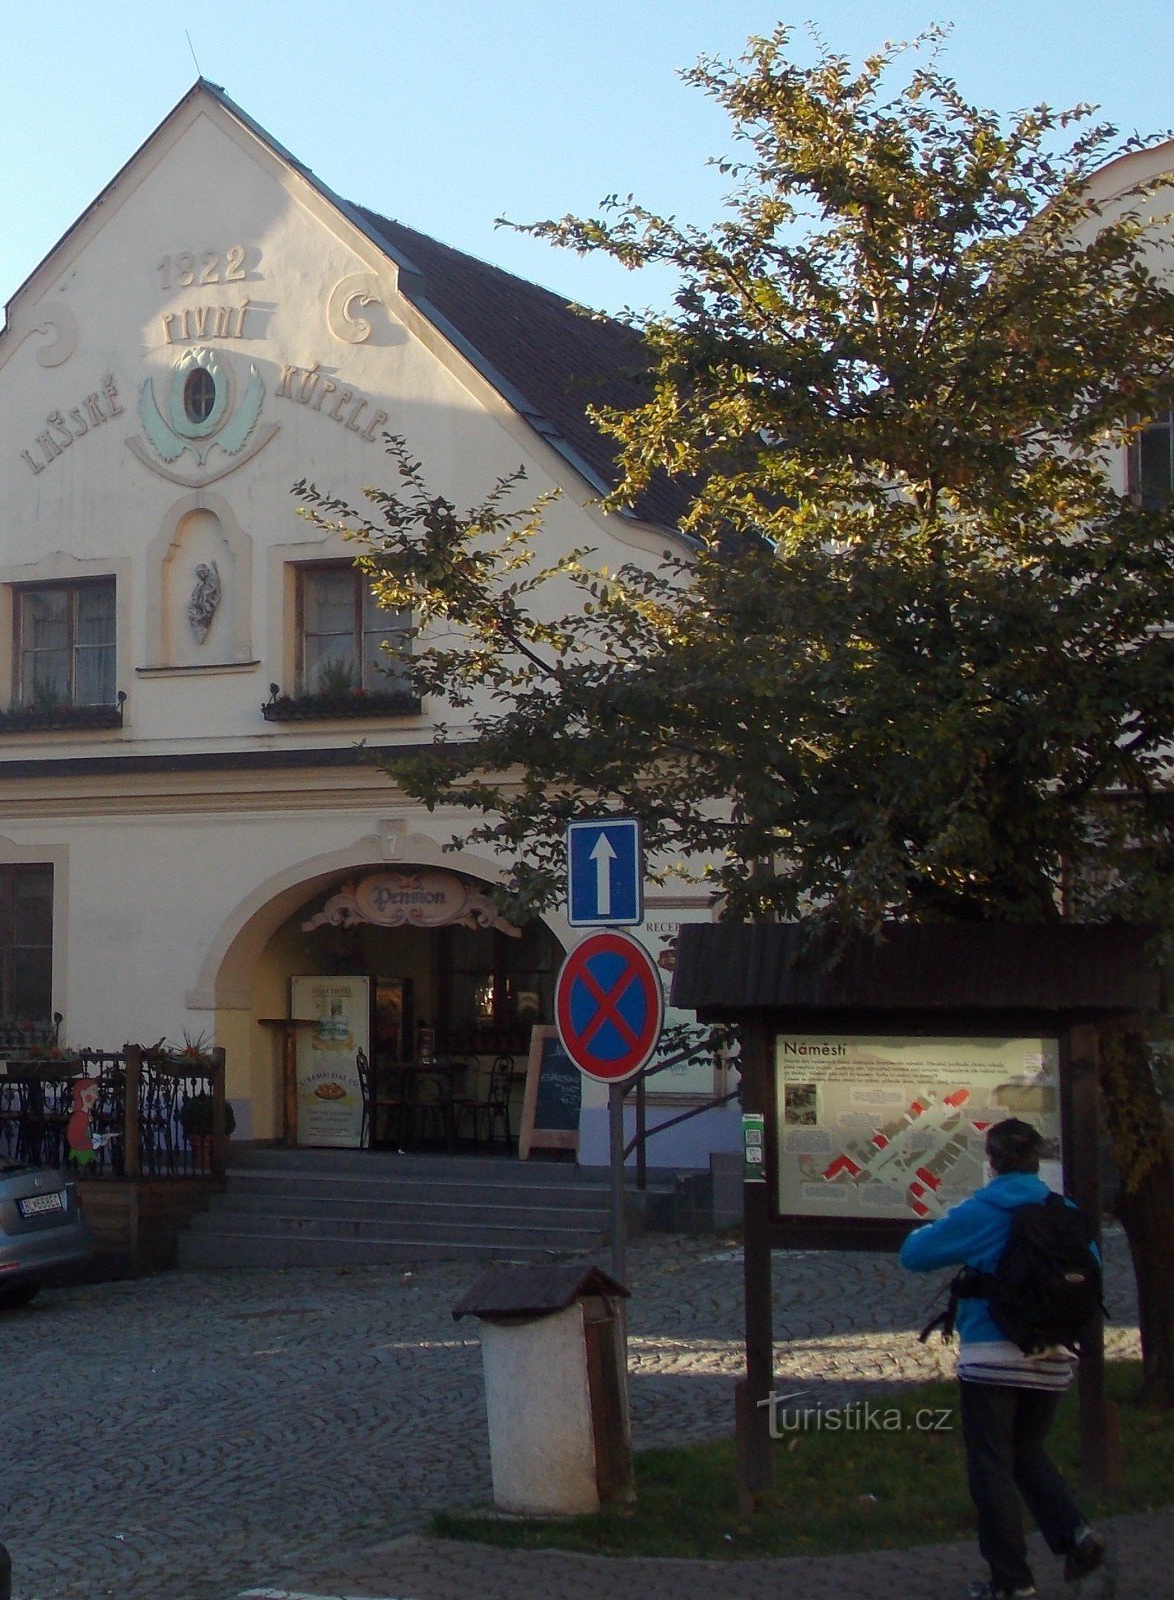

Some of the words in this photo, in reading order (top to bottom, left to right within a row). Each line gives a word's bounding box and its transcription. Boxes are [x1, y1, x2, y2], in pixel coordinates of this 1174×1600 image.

[157, 245, 246, 290] 1822
[161, 295, 250, 344] PIVNÍ
[371, 885, 446, 912] Pension
[784, 1041, 848, 1056] Náměstí
